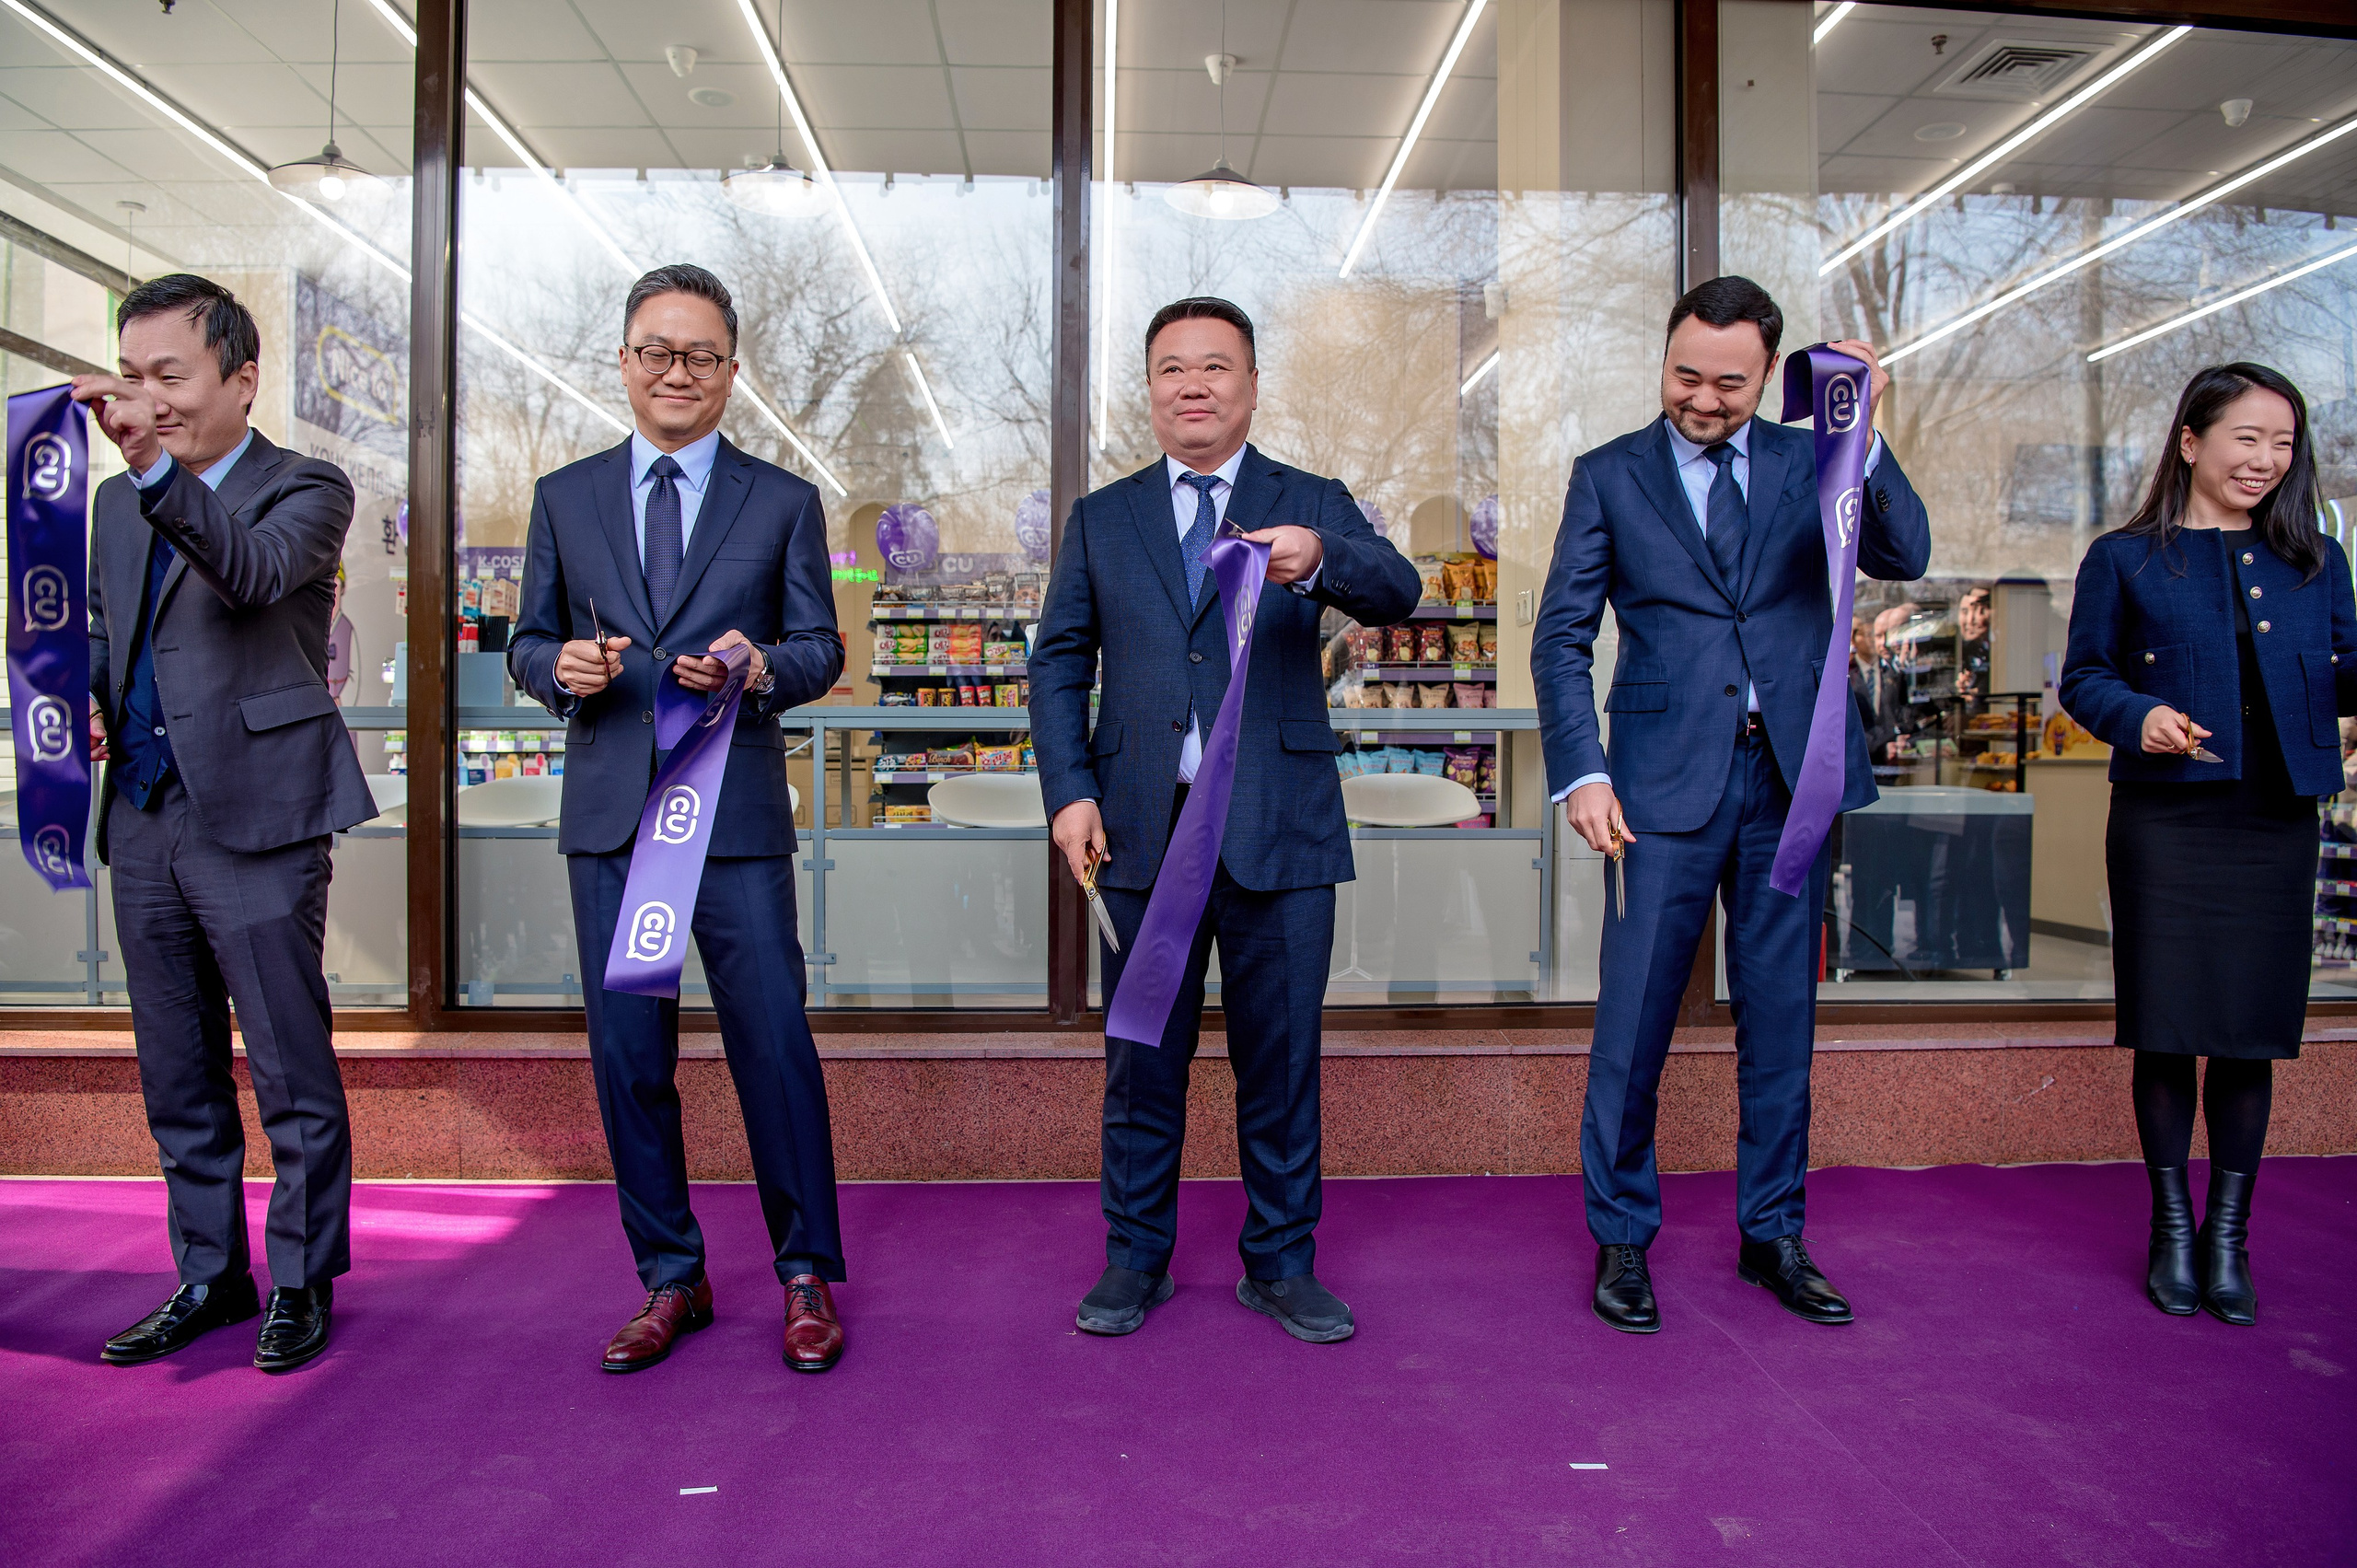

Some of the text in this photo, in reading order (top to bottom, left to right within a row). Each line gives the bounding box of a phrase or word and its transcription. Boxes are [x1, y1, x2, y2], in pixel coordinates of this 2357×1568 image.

[1832, 384, 1851, 421] CU
[35, 445, 60, 489] CU
[1024, 532, 1046, 543] CU
[894, 553, 919, 565] CU
[942, 556, 974, 574] CU
[35, 576, 58, 620] CU
[39, 705, 62, 749] CU
[666, 796, 691, 833] CU
[42, 837, 66, 876] CU
[640, 912, 666, 951] CU
